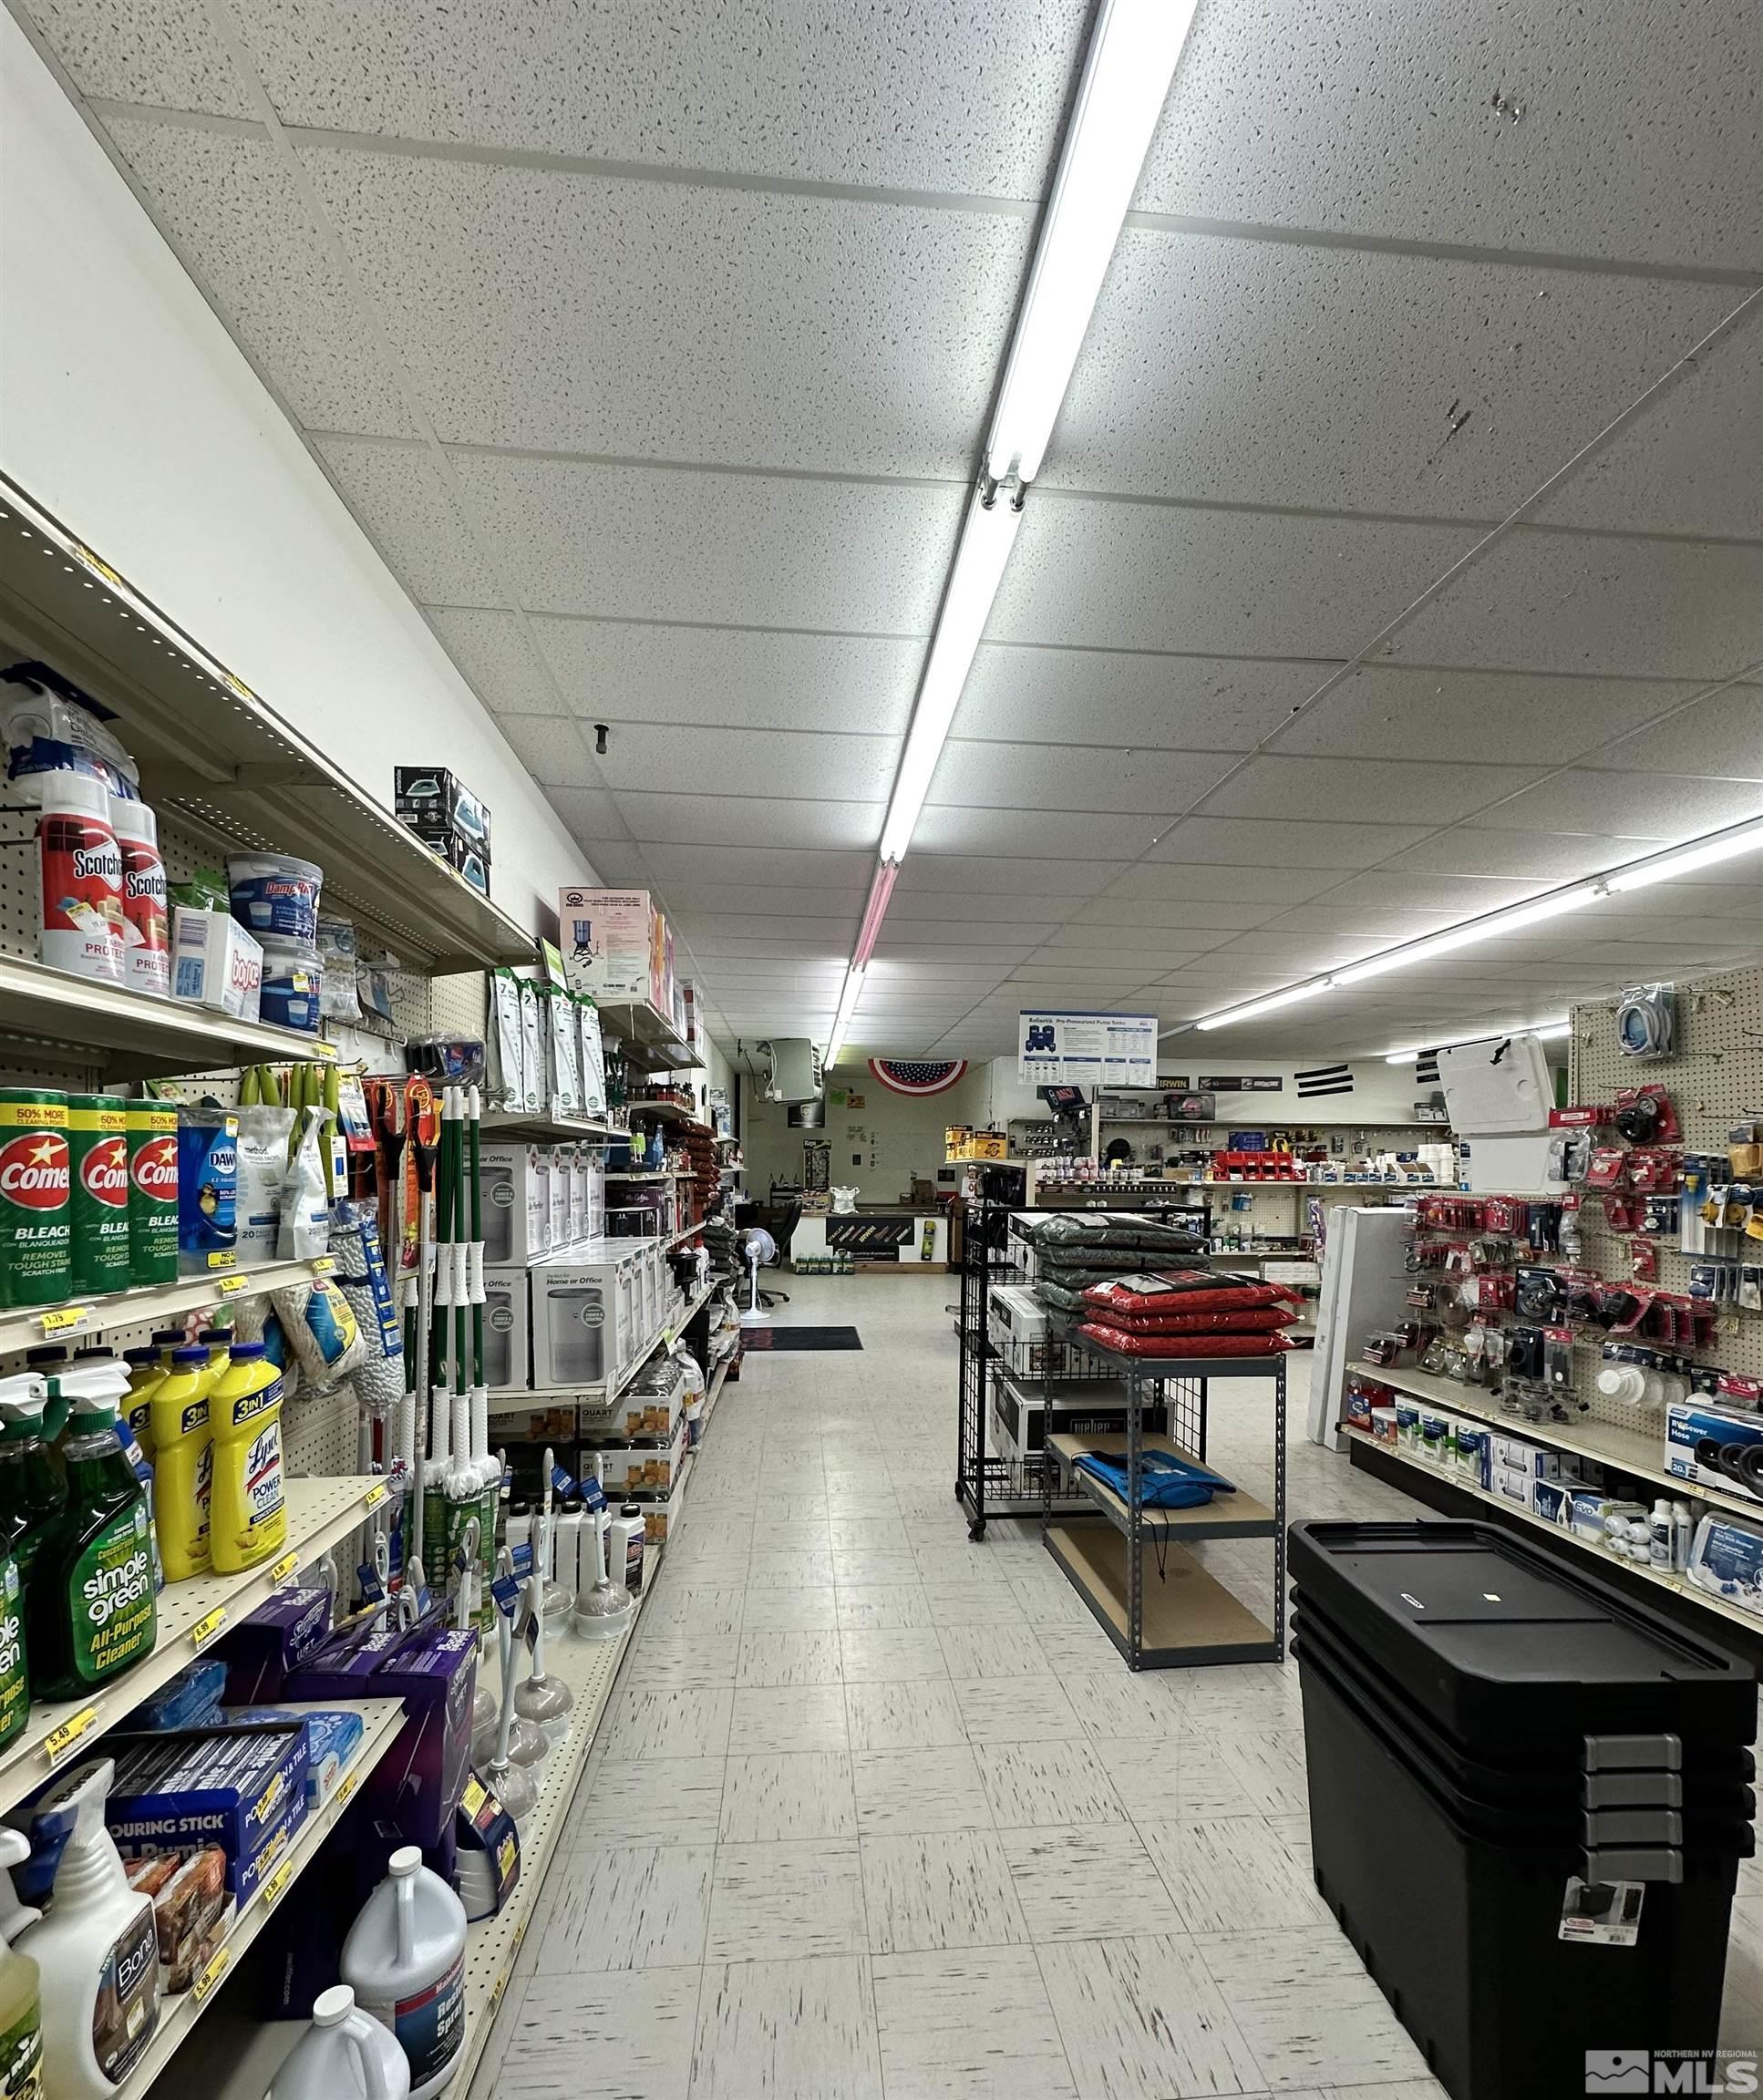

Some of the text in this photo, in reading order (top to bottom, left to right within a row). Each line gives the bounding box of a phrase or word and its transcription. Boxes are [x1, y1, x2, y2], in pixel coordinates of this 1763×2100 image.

[1160, 1079, 1187, 1088] IRWIN
[17, 1108, 66, 1119] 50% MORE
[88, 1164, 128, 1189] Com
[138, 1161, 179, 1185] Com
[99, 1221, 129, 1234] BLEA
[149, 1214, 179, 1227] BLEAC
[15, 1225, 70, 1240] BLEACH
[242, 1230, 254, 1239] 20
[859, 1225, 877, 1243] IRWIN
[7, 1261, 50, 1271] TOUGH
[22, 1250, 67, 1261] REMOVES
[1671, 1429, 1690, 1440] Hose
[248, 1426, 279, 1474] Lysol
[253, 1474, 281, 1499] POWER
[1574, 1502, 1593, 1516] Evo
[83, 1549, 148, 1601] simple
[88, 1574, 149, 1626] green
[90, 1603, 152, 1652] All-Purpose
[95, 1632, 143, 1670] Cleaner
[50, 1727, 70, 1746] 5.49
[293, 1743, 307, 1766] TILE
[292, 1794, 305, 1819] TILE
[108, 1814, 224, 1839] OURING STICK
[117, 1929, 154, 1989] Bona
[195, 1973, 211, 1994] 5.99
